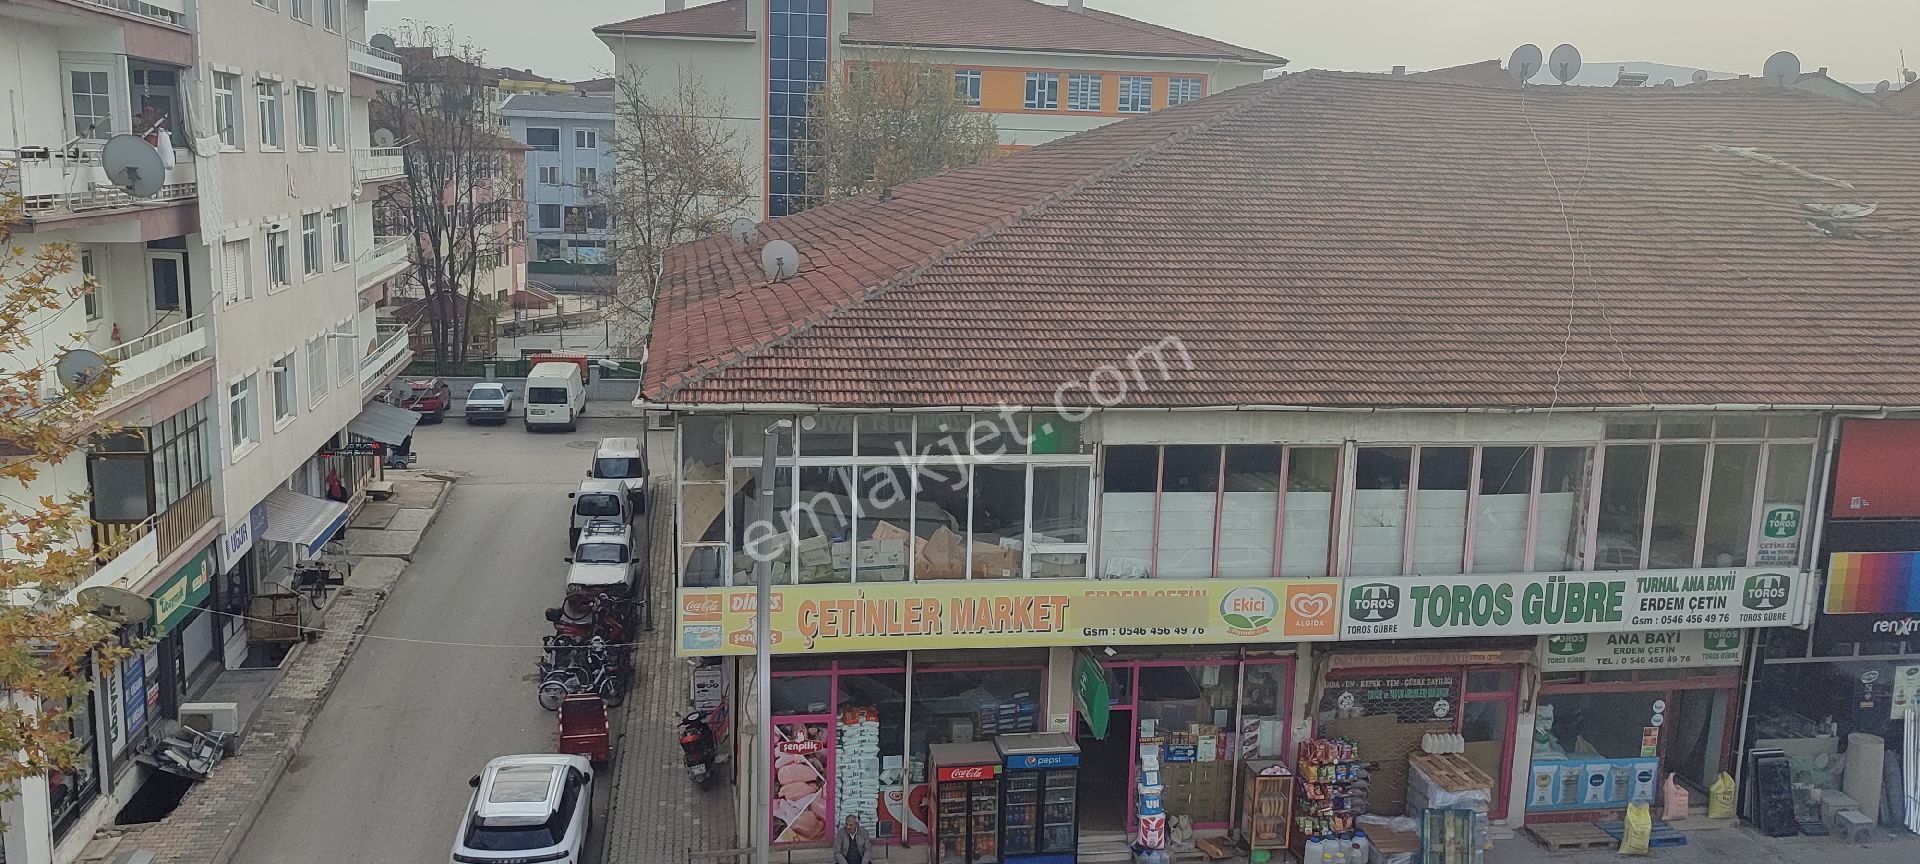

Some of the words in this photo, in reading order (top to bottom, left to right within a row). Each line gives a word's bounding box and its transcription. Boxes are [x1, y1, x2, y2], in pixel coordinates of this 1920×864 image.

[1769, 520, 1797, 528] TOROS
[1636, 576, 1680, 593] TURHAL
[1681, 575, 1706, 592] ANA
[1748, 587, 1785, 599] TOROS
[1233, 597, 1265, 612] Ekici
[1354, 598, 1395, 610] TOROS
[1409, 582, 1514, 628] TOROS
[1521, 575, 1626, 626] GÜBRE
[1640, 597, 1685, 612] ERDEM
[1688, 592, 1728, 614] ÇETİN
[797, 588, 943, 650] ÇETİNLER
[951, 595, 1070, 634] MARKET
[1631, 616, 1653, 625] Gsm
[1661, 614, 1684, 625] 0546
[1685, 614, 1703, 624] 456
[1704, 613, 1717, 623] 49
[1718, 612, 1730, 622] 76
[1738, 613, 1762, 622] TOROS
[683, 626, 721, 635] PEPSI
[1083, 627, 1109, 637] Gsm
[1347, 624, 1372, 635] TOROS
[1707, 630, 1738, 639] TOROS
[1606, 633, 1640, 646] ANA
[1613, 647, 1645, 655] ERDEM
[1647, 645, 1676, 656] ÇETİN
[1702, 652, 1720, 660] TOROS
[1547, 656, 1566, 664] TOROS
[1596, 657, 1613, 665] TEL
[1629, 656, 1646, 664] 546
[1647, 655, 1664, 664] 456
[1667, 655, 1678, 663] 49
[1679, 655, 1691, 663] 76
[783, 741, 819, 754] şenpiliç
[1037, 755, 1061, 766] pepsi
[1145, 799, 1160, 809] UN
